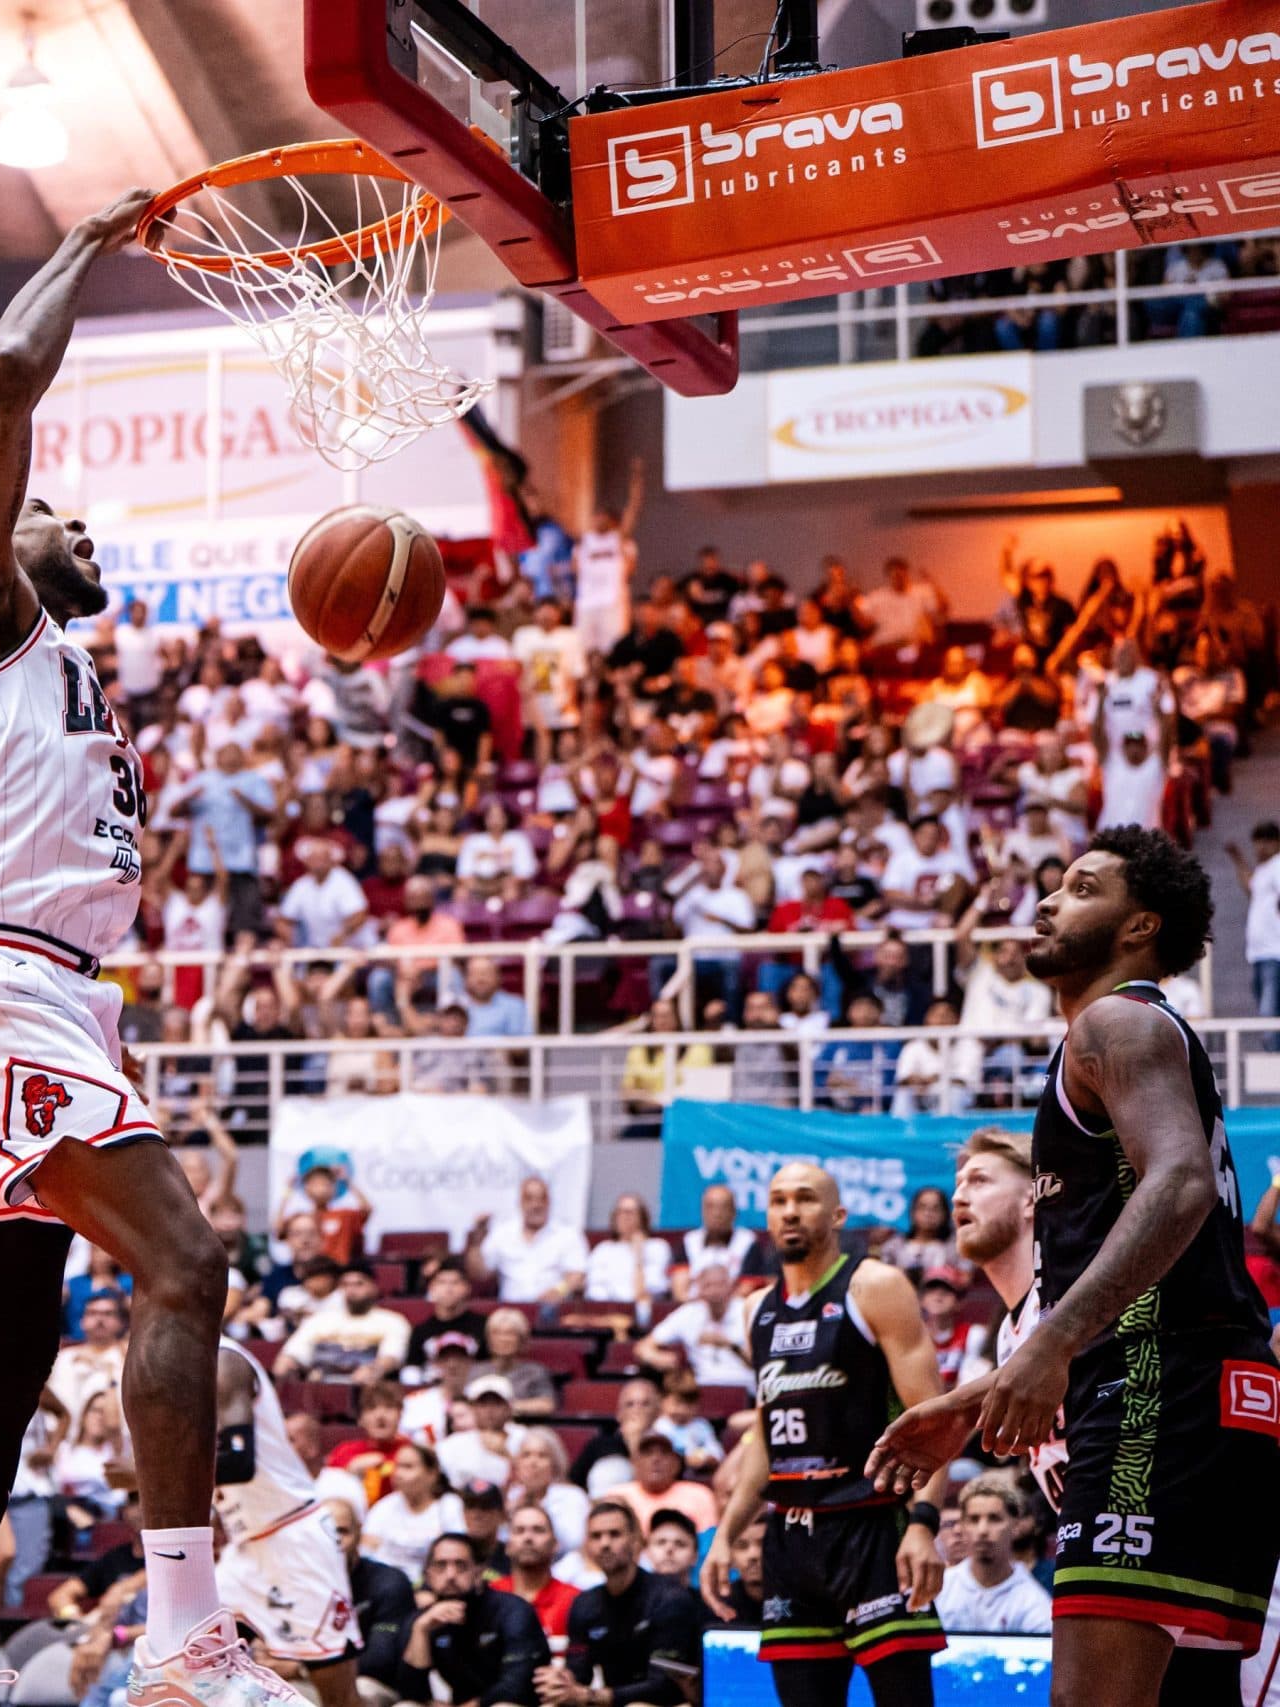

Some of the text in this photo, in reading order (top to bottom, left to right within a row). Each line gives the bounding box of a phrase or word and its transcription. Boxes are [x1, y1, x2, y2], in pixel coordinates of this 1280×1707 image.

[1069, 32, 1280, 95] brava
[1074, 78, 1280, 129] lubricants
[700, 102, 903, 165] brava
[705, 146, 907, 199] lubricants
[643, 265, 848, 304] brava
[33, 402, 320, 472] ROPIGAS
[810, 399, 995, 435] TROPIGAS
[769, 1408, 807, 1445] 26
[1092, 1513, 1155, 1556] 25
